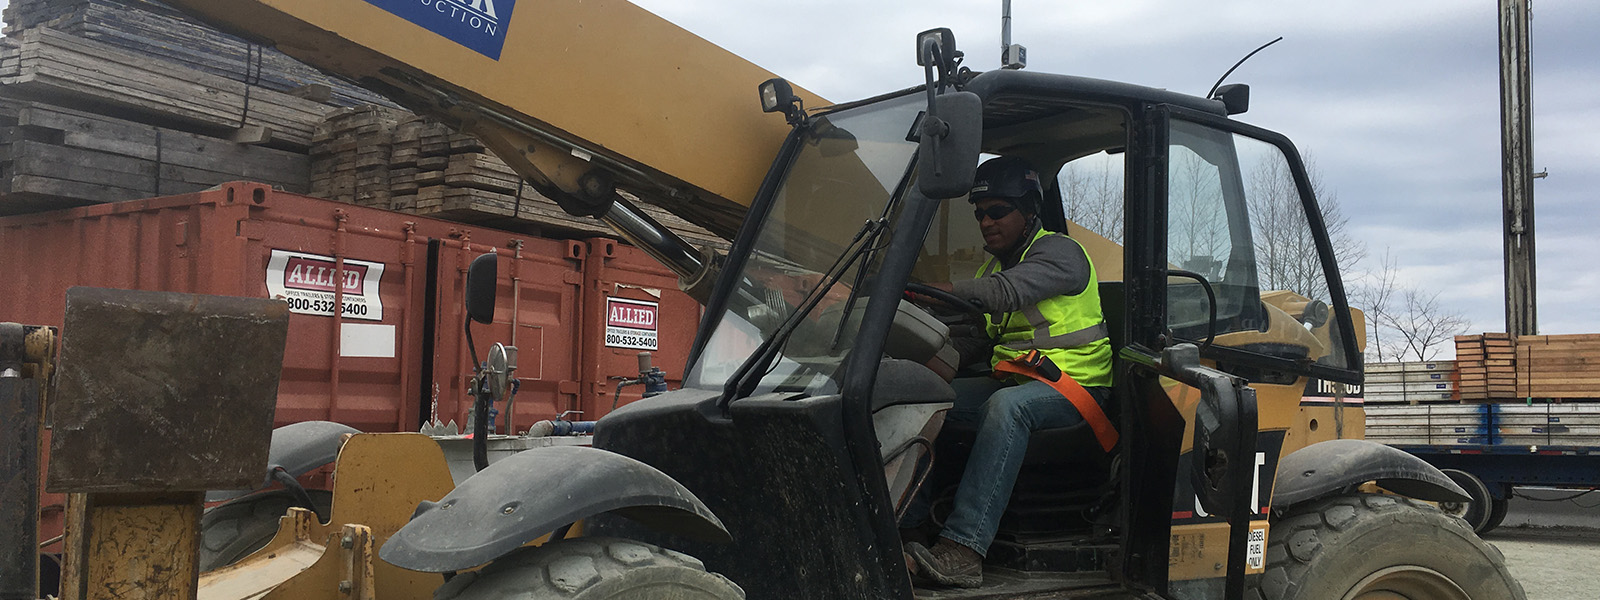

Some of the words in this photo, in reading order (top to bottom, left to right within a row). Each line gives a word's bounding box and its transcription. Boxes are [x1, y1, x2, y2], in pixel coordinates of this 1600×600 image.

[609, 306, 654, 326] ALLIED
[606, 334, 657, 347] 800-532-5400
[1248, 531, 1264, 542] DIESEL
[1250, 544, 1261, 555] FUEL
[1249, 556, 1262, 567] ONLY
